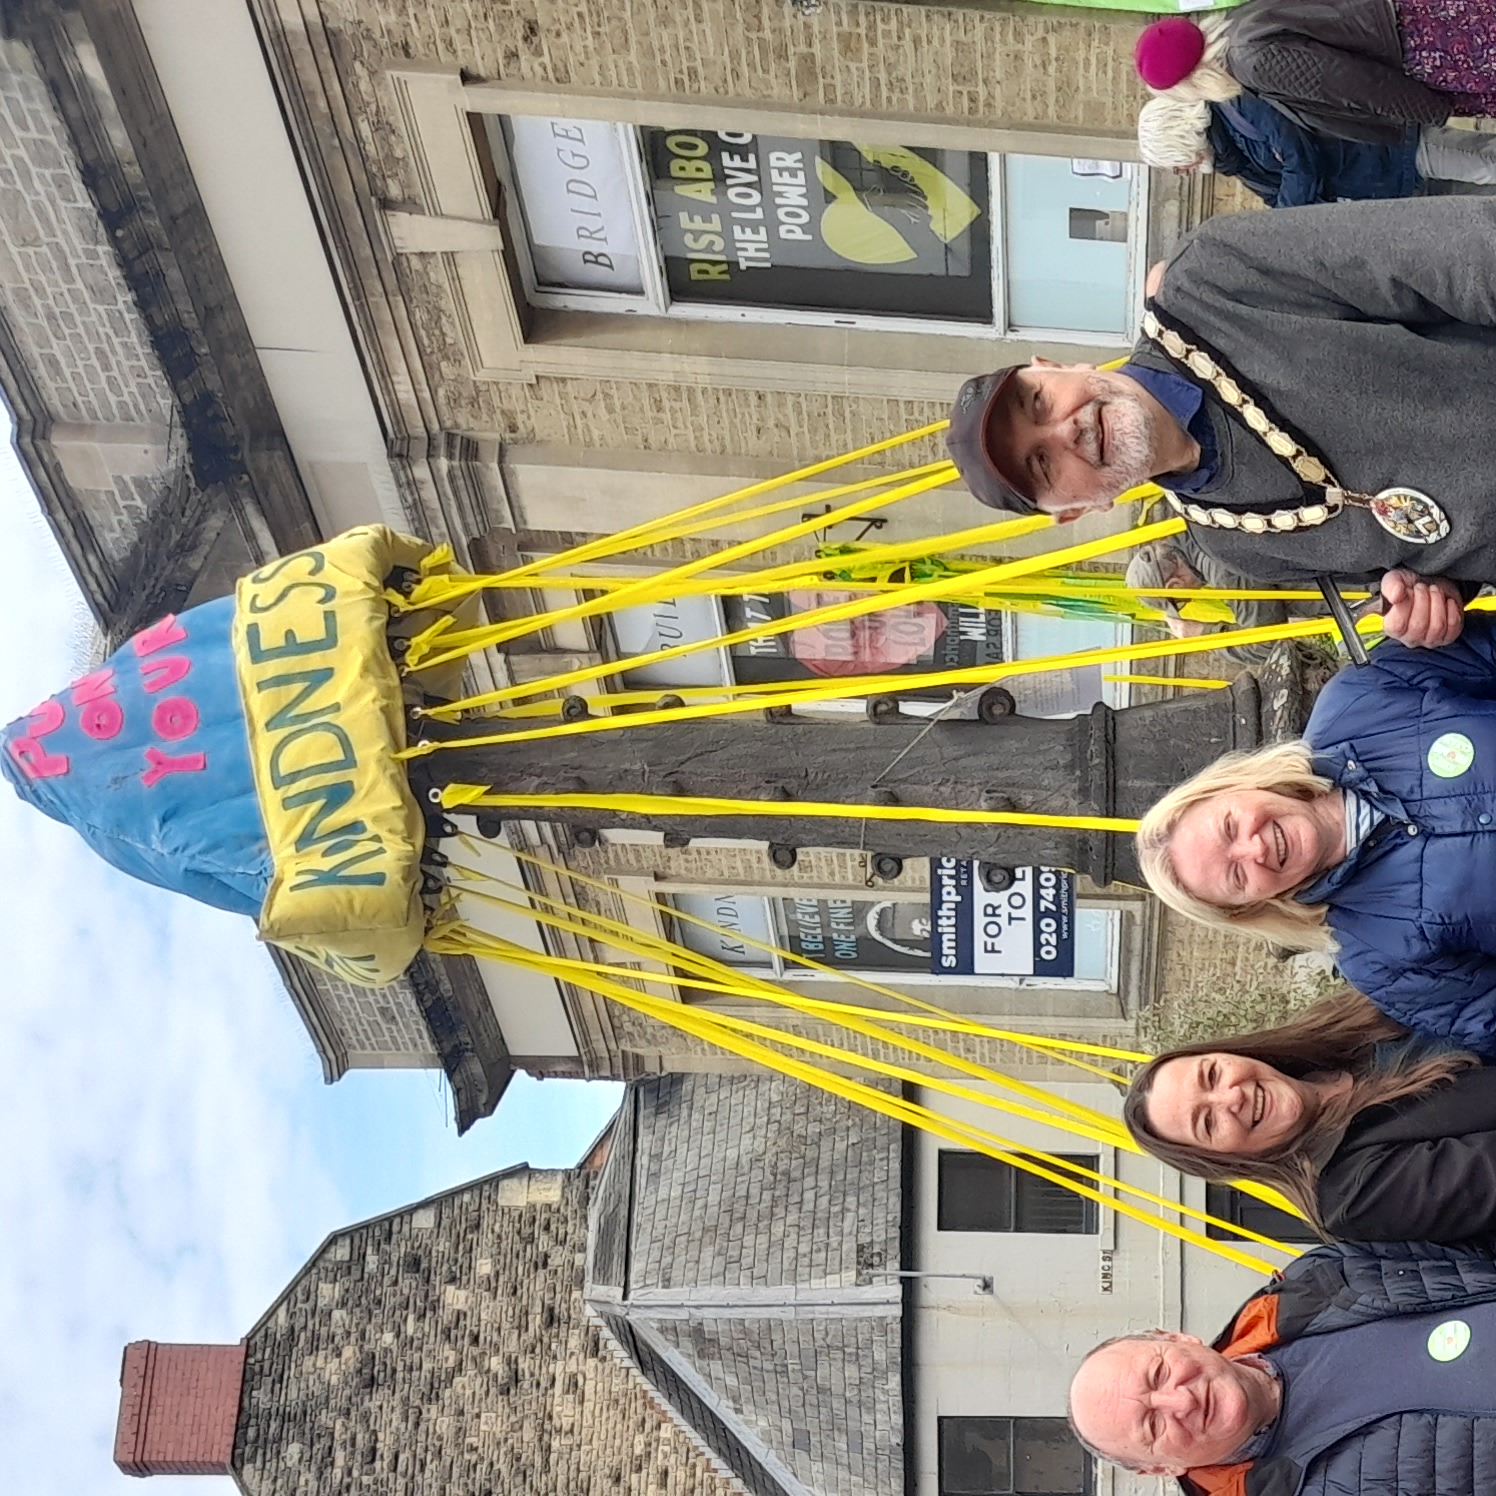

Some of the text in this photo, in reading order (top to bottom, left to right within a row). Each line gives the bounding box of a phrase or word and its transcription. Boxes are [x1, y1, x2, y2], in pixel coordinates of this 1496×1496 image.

[550, 121, 615, 271] BRIDGE
[663, 128, 731, 281] RISE ABO
[720, 151, 763, 219] LOVE
[769, 151, 813, 240] POWER
[733, 225, 772, 270] THE
[744, 607, 778, 655] THT
[958, 606, 987, 641] WILL
[71, 668, 124, 740] ON
[132, 612, 206, 788] YOUR
[246, 551, 387, 891] KINDNESS
[794, 898, 825, 951] BELIEVE
[827, 899, 859, 959] ONE FINE
[937, 857, 962, 968] smithpric
[983, 902, 1002, 954] FOR
[1007, 891, 1026, 926] TO
[1040, 917, 1057, 960] 020
